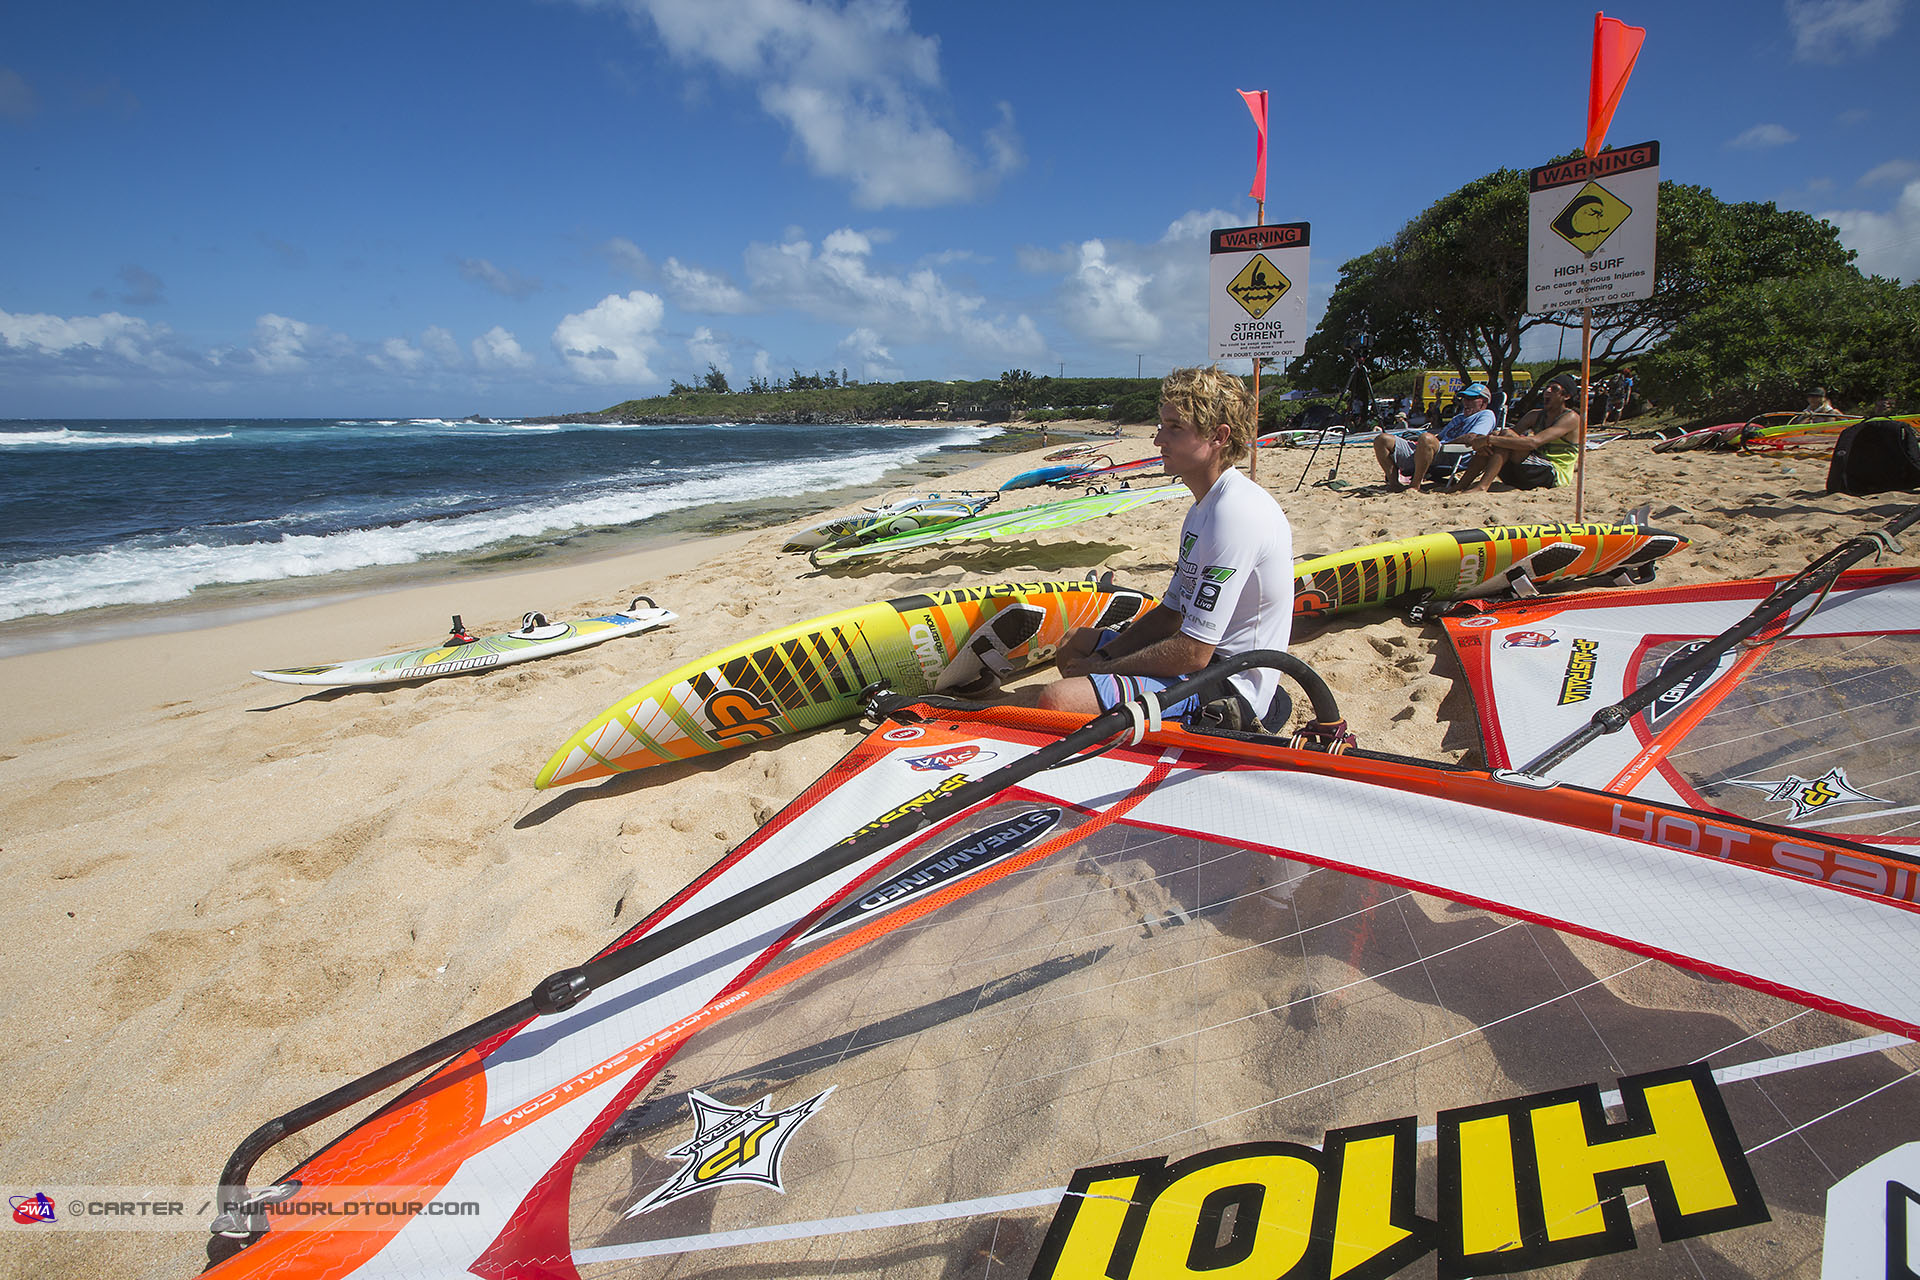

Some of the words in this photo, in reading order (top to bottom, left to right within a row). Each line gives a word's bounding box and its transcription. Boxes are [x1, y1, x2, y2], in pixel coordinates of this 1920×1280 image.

[1543, 150, 1645, 183] WARNING
[1226, 230, 1296, 246] WARNING
[1554, 264, 1584, 277] HIGH
[1589, 257, 1625, 272] SURF
[1535, 283, 1551, 292] Can
[1553, 281, 1577, 289] cause
[1580, 275, 1611, 286] serious
[1564, 288, 1573, 296] or
[1575, 283, 1613, 295] drowning
[1585, 295, 1605, 304] DON'T
[1621, 291, 1636, 299] OUT
[1234, 321, 1282, 332] STRONG
[1231, 330, 1285, 341] CURRENT
[1449, 377, 1462, 385] FIS
[1196, 599, 1212, 609] Live
[1559, 639, 1599, 706] JP-AUSTRALIA
[916, 750, 974, 767] PWA
[1610, 803, 1751, 859] HOT
[858, 811, 1053, 911] STREAMLINED
[681, 1104, 763, 1156] AUSTRALIA
[695, 1116, 778, 1181] JP
